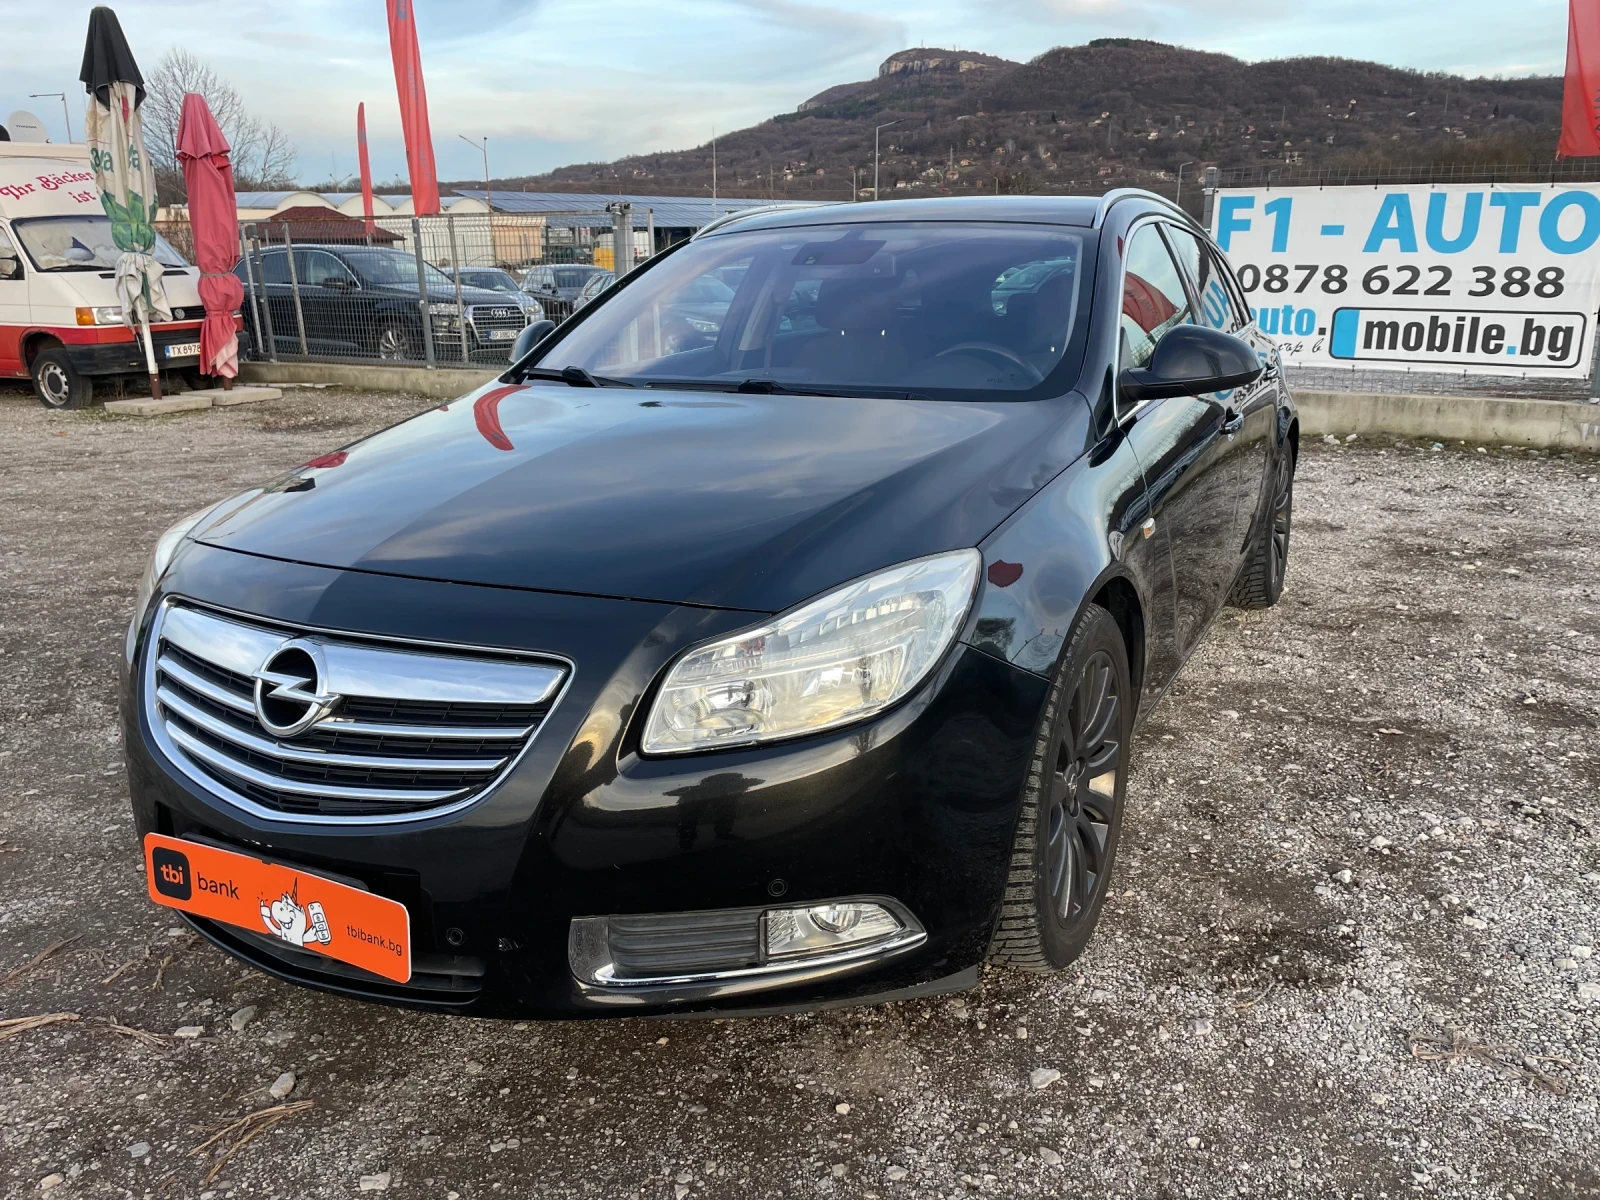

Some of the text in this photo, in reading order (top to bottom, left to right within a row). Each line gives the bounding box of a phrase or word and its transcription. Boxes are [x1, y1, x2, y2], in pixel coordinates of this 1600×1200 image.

[0, 171, 95, 200] Ihr Bäcker
[67, 190, 97, 203] ist
[1217, 195, 1293, 253] F1
[1362, 190, 1600, 255] AUTO
[1236, 264, 1565, 298] 0878 622 388
[1363, 316, 1574, 361] mobile.bg
[160, 864, 240, 900] tbi bank
[346, 924, 403, 956] tbibank.bg
